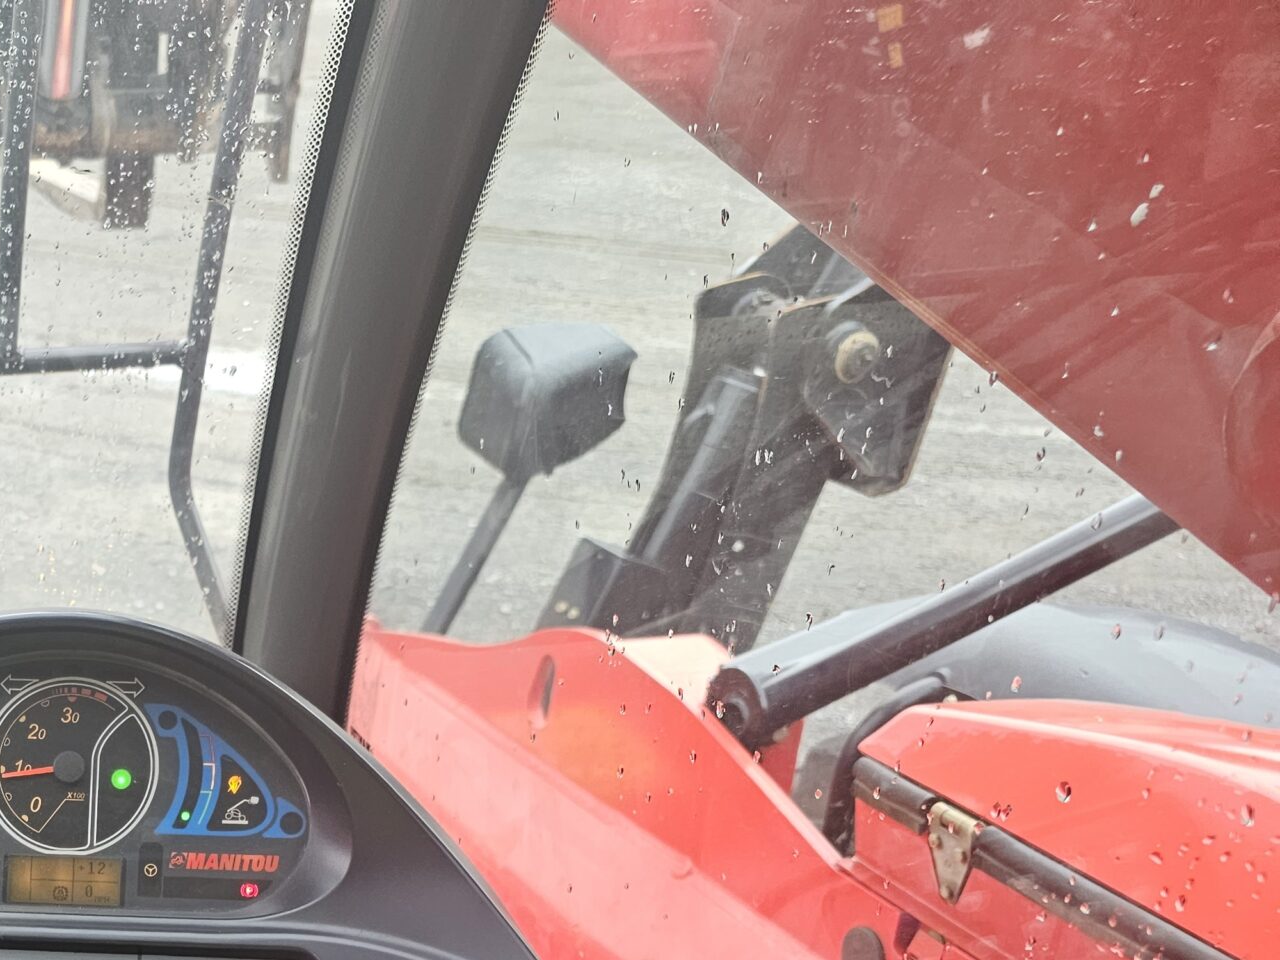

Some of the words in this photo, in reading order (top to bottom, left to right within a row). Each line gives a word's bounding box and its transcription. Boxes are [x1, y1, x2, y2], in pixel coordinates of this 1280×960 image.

[61, 707, 80, 723] 30
[27, 723, 46, 740] 20
[30, 796, 42, 813] 0
[186, 852, 280, 873] MANITOU
[85, 884, 93, 898] 0
